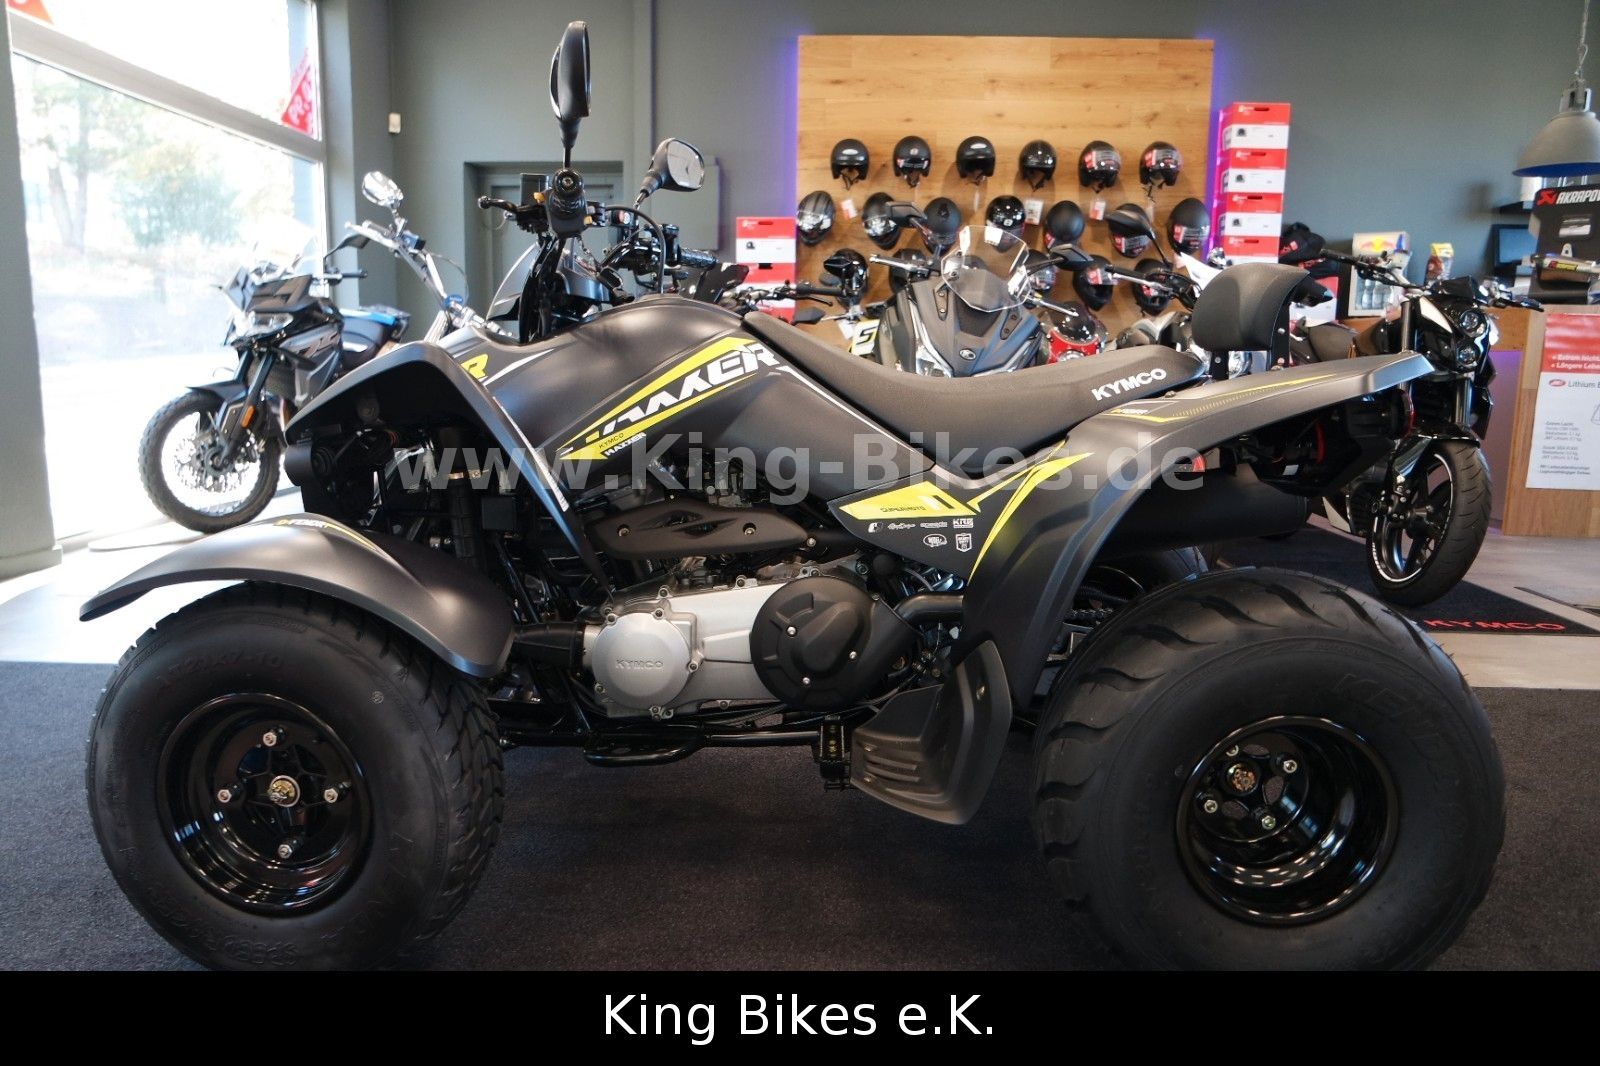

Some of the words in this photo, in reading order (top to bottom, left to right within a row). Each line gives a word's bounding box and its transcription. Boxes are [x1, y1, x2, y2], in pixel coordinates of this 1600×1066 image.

[1091, 368, 1167, 401] KYMCO
[598, 432, 625, 449] KYMCO
[1423, 619, 1566, 631] KYMCO
[615, 658, 664, 671] KYMCO
